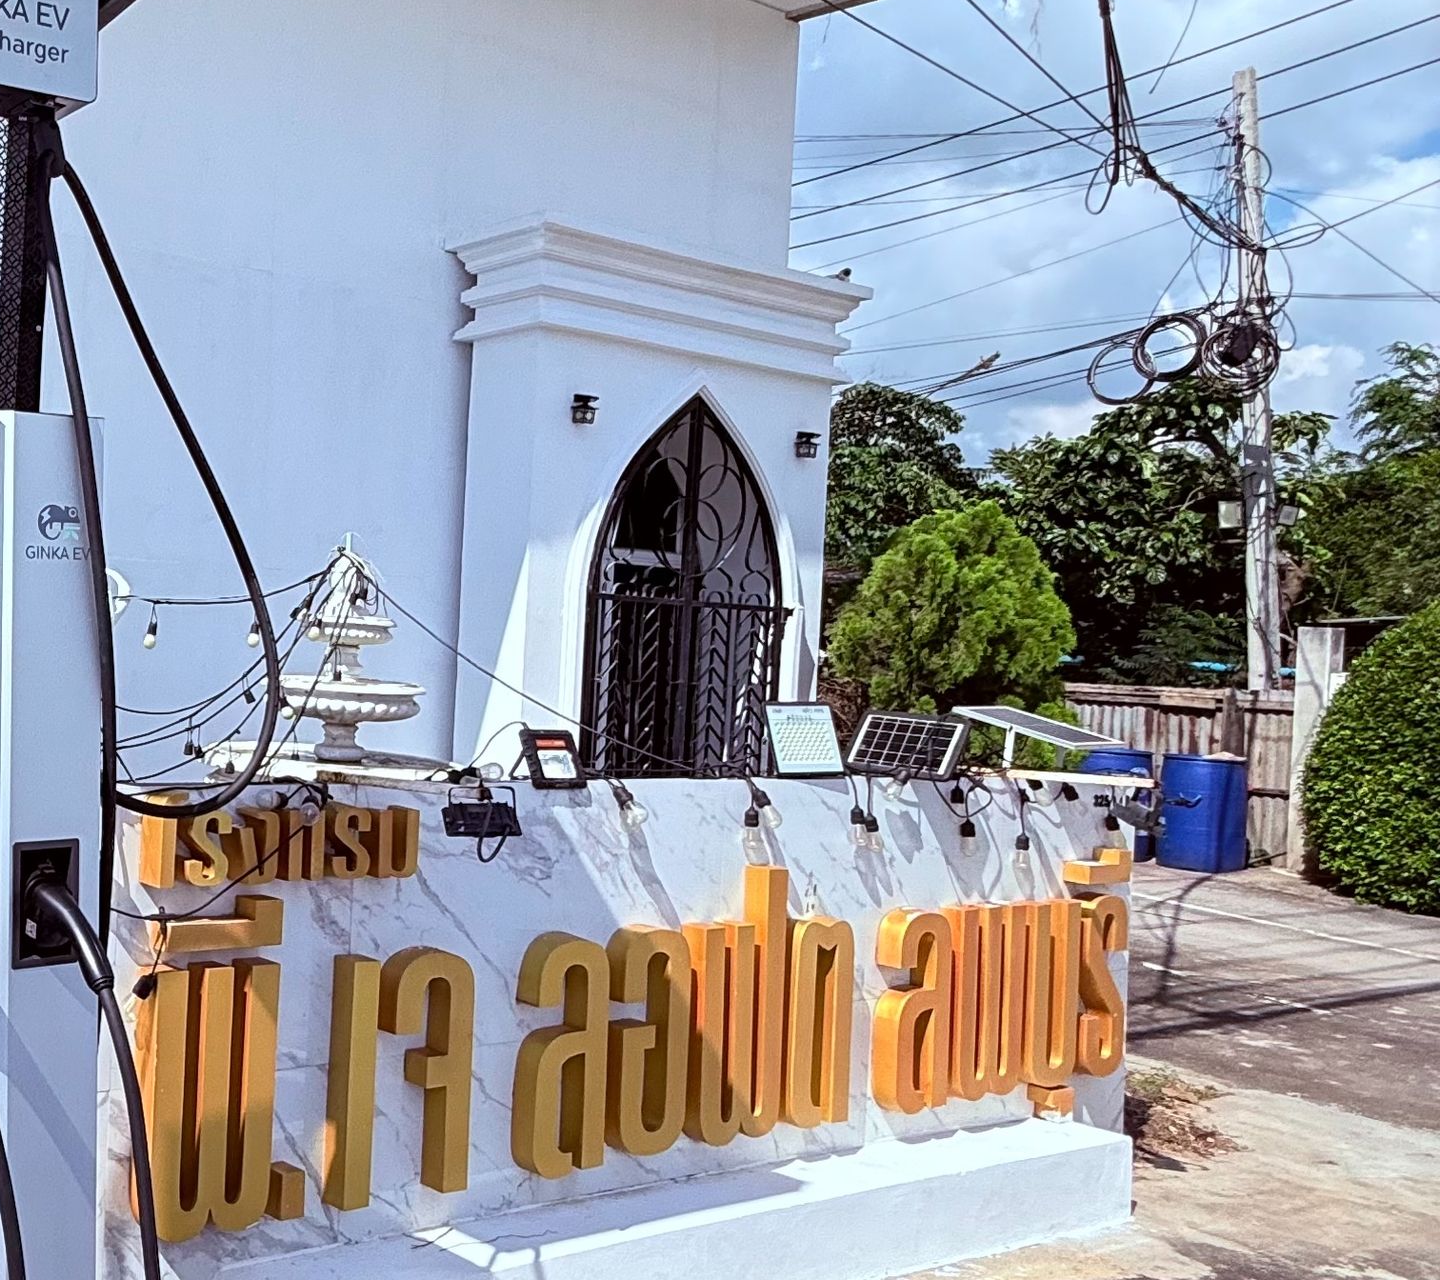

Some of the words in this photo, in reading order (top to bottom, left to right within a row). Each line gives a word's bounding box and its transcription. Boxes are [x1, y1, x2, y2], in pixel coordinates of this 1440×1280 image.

[36, 1, 70, 31] EV
[25, 545, 69, 560] GINKA
[72, 547, 91, 561] EV
[139, 791, 420, 888] โรงแรม
[131, 894, 474, 1243] พี.เจ
[870, 847, 1133, 1121] ลพบุรี
